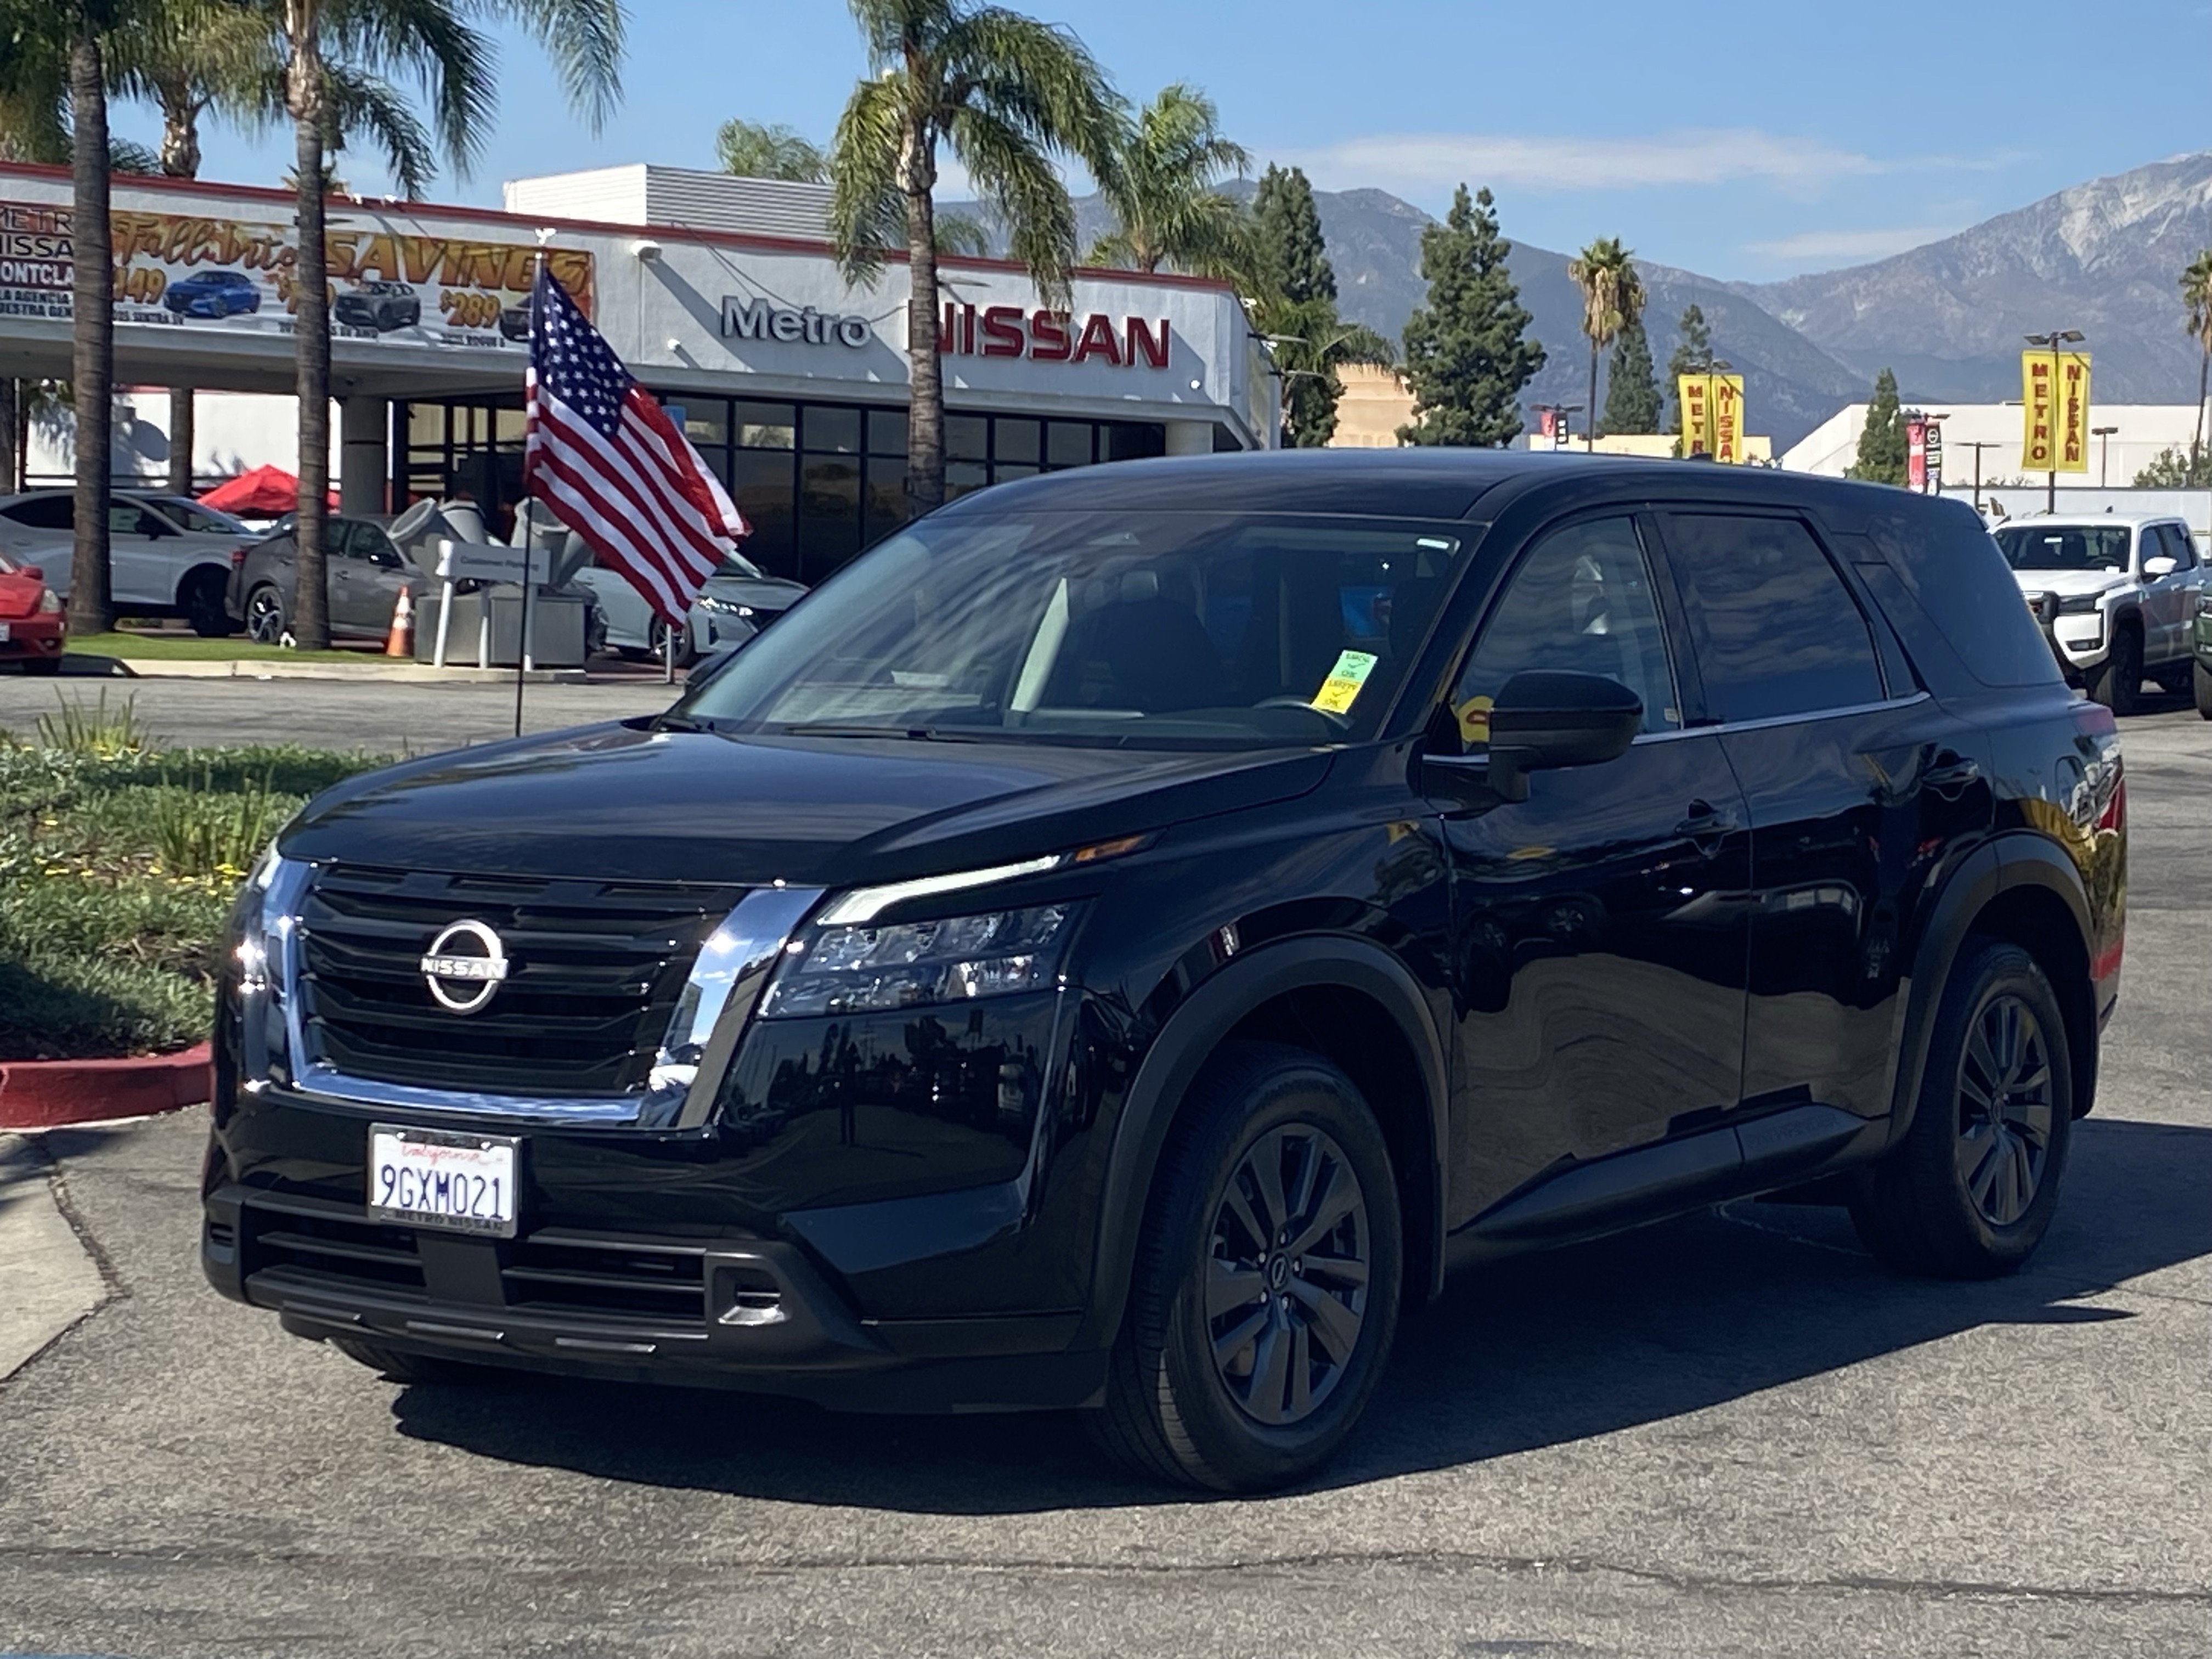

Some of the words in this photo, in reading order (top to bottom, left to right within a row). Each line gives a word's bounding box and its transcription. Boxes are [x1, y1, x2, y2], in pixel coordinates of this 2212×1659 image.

[0, 207, 74, 233] ETR
[0, 234, 74, 257] ISSA
[111, 217, 213, 267] Fall
[323, 232, 590, 295] SAVINGS
[0, 261, 74, 286] ONTCLA
[114, 267, 167, 304] 149
[440, 289, 501, 329] $289
[721, 295, 871, 348] Metro
[1688, 385, 1704, 454] METR
[1719, 386, 1733, 462] NISSA
[2032, 363, 2049, 460] METRO
[421, 958, 506, 979] NISSAN
[381, 1164, 504, 1221] 9GXM021
